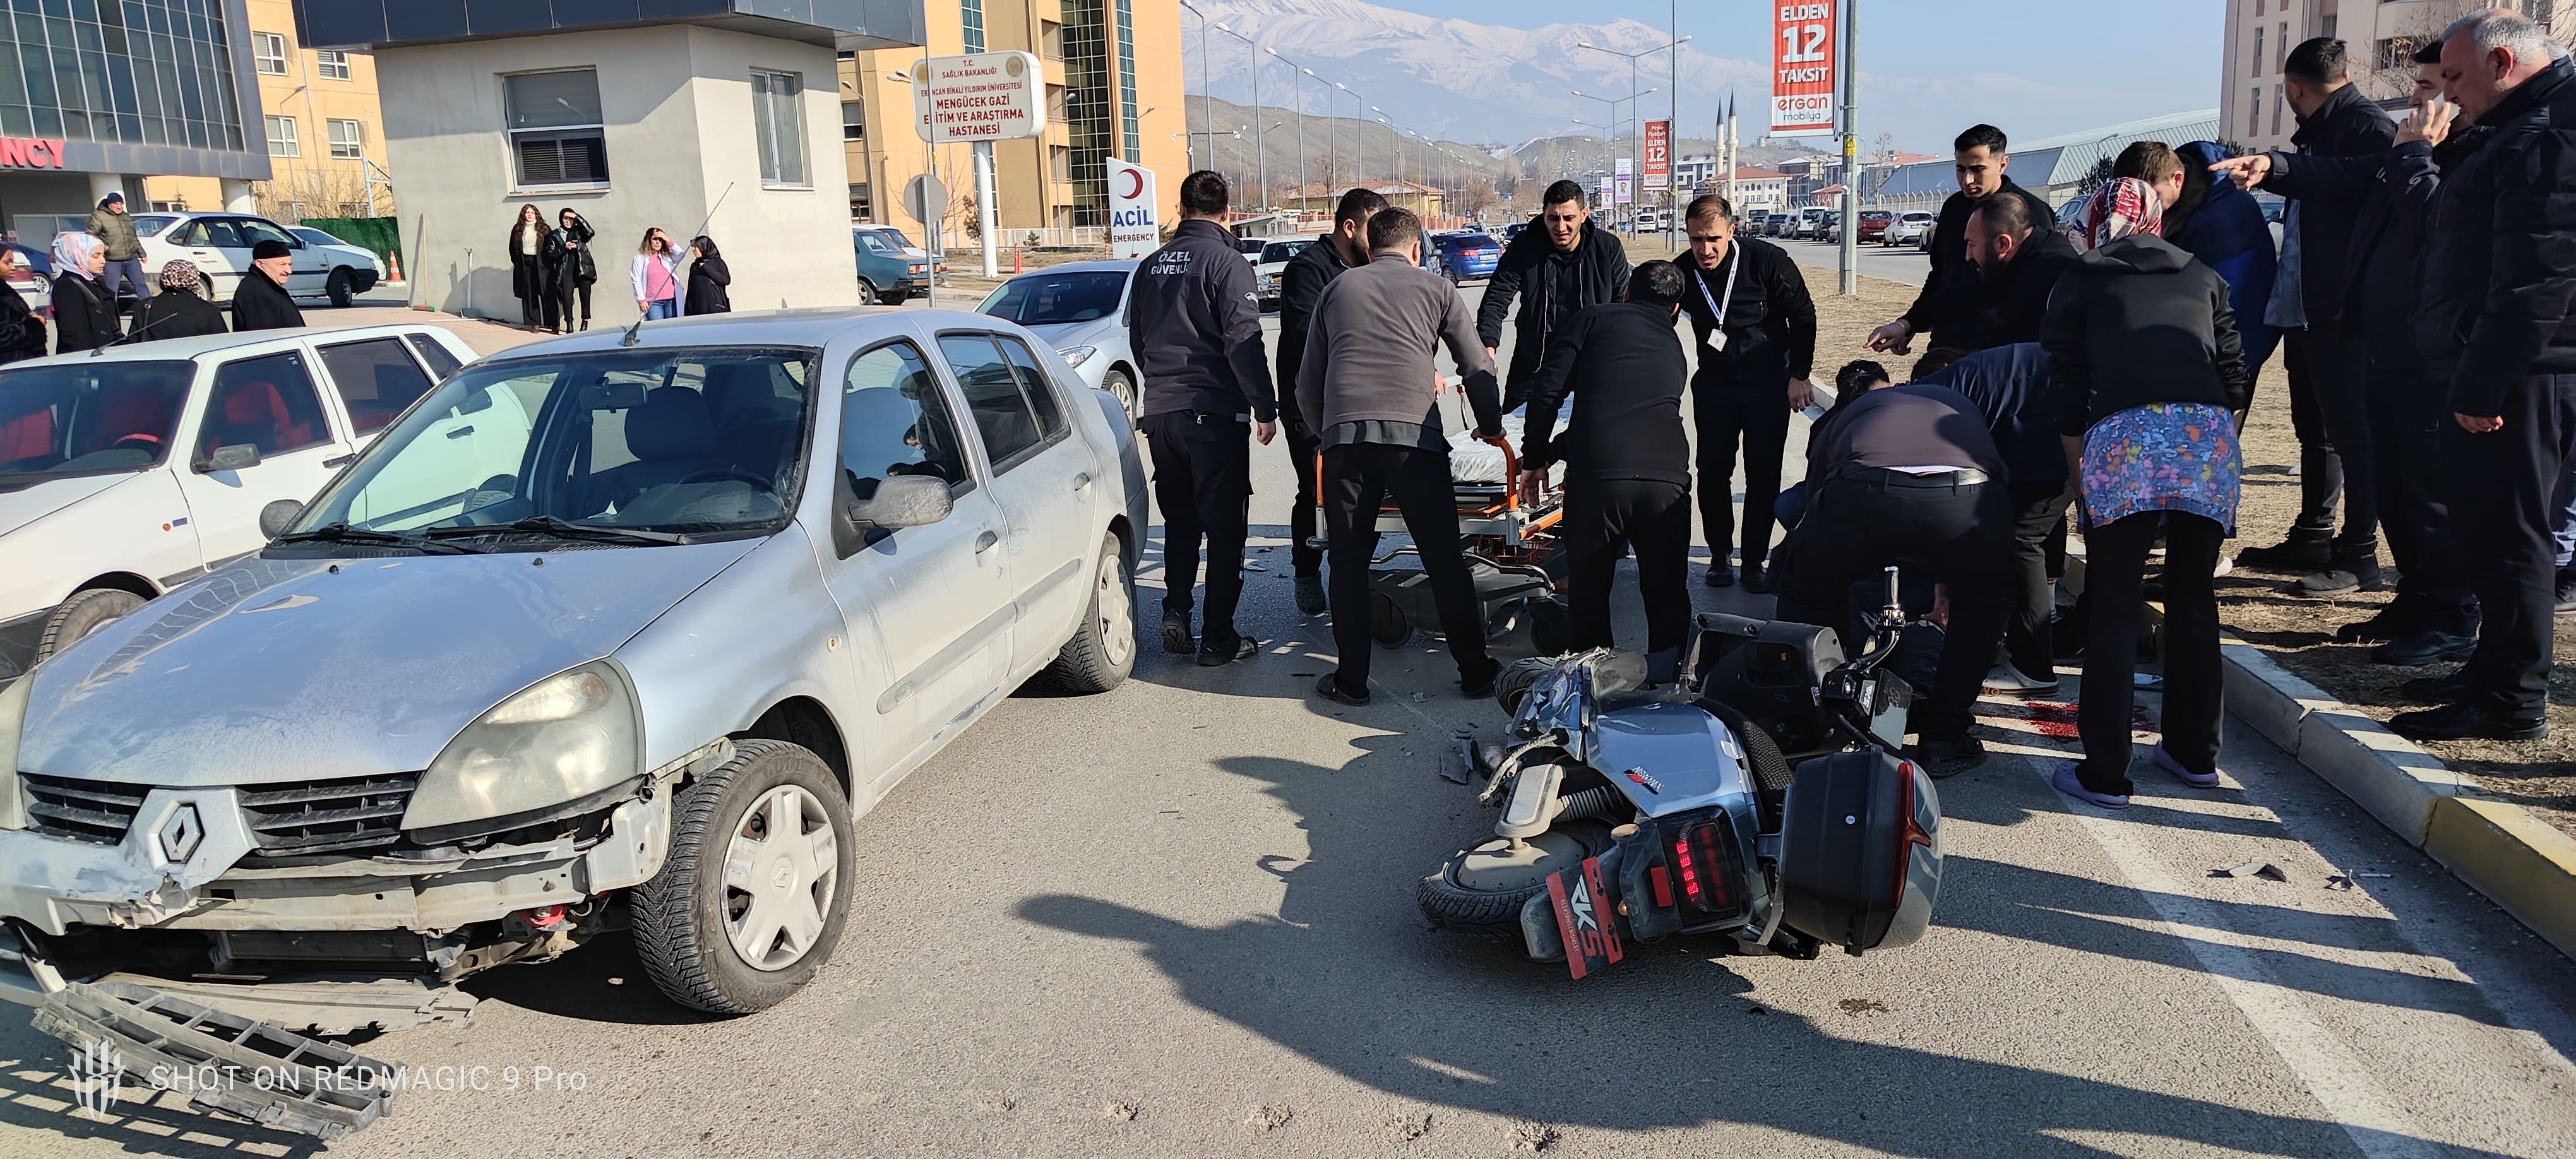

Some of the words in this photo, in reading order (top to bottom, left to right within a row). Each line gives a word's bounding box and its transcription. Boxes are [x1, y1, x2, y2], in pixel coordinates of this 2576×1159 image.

[1780, 3, 1829, 21] ELDEN
[1782, 24, 1826, 63] 12
[942, 69, 963, 78] SAĞLIK
[965, 68, 997, 76] BAKANLIĞI
[921, 86, 946, 97] ERNCAN
[946, 85, 963, 94] BİNALİ
[964, 83, 986, 93] YILDIRIM
[987, 80, 1022, 92] ÜNİVERSİTESİ
[936, 96, 987, 109] MENGÜCEK
[989, 93, 1010, 105] GAZİ
[924, 111, 954, 124] EİTİM
[957, 112, 968, 122] VE
[970, 109, 1023, 121] ARAŞTIRMA
[1784, 112, 1821, 122] mobilya
[949, 122, 1000, 136] HASTANESİ
[1648, 147, 1666, 162] 12
[1113, 205, 1153, 227] ACİL
[1113, 233, 1154, 242] EMERGENCY
[1158, 251, 1191, 263] ÖZEL
[1570, 874, 1604, 956] RKS
